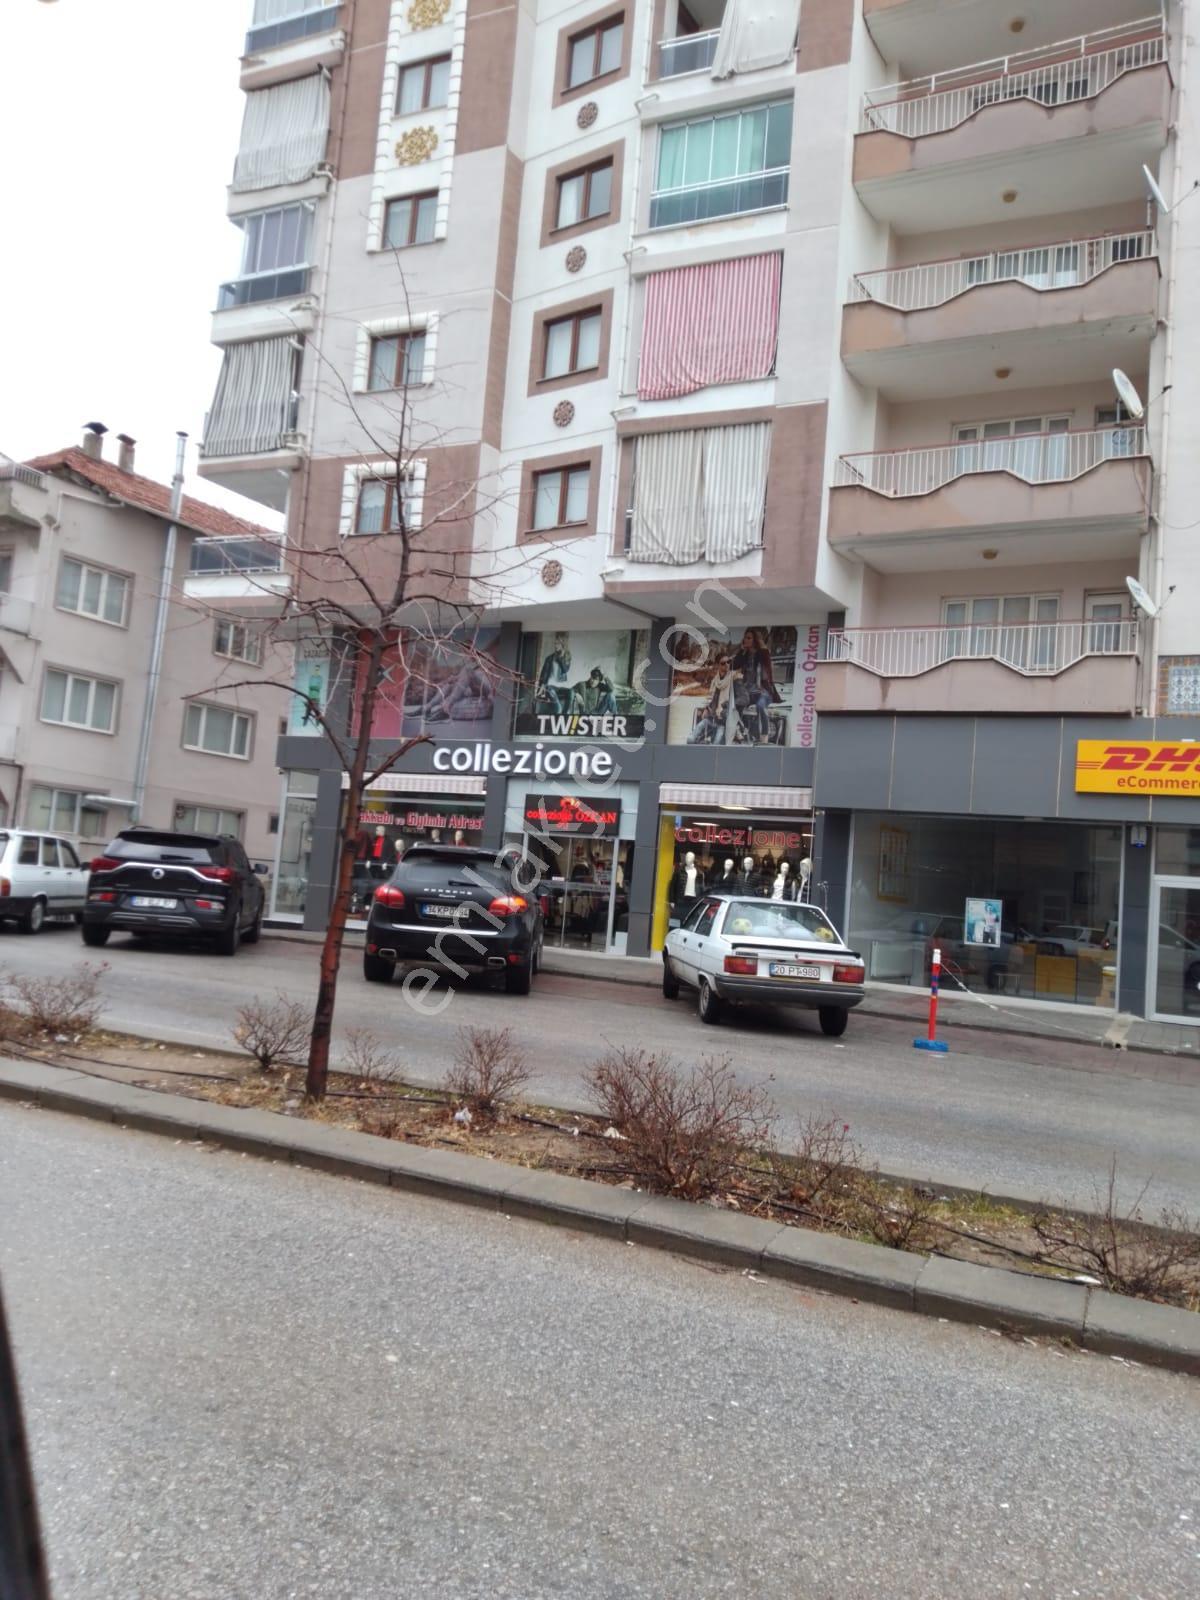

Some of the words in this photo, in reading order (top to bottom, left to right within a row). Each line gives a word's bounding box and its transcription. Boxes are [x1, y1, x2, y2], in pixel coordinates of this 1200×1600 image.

[797, 676, 817, 747] collezione
[432, 742, 613, 777] collezione
[1100, 746, 1200, 772] DH
[674, 825, 801, 849] collezione
